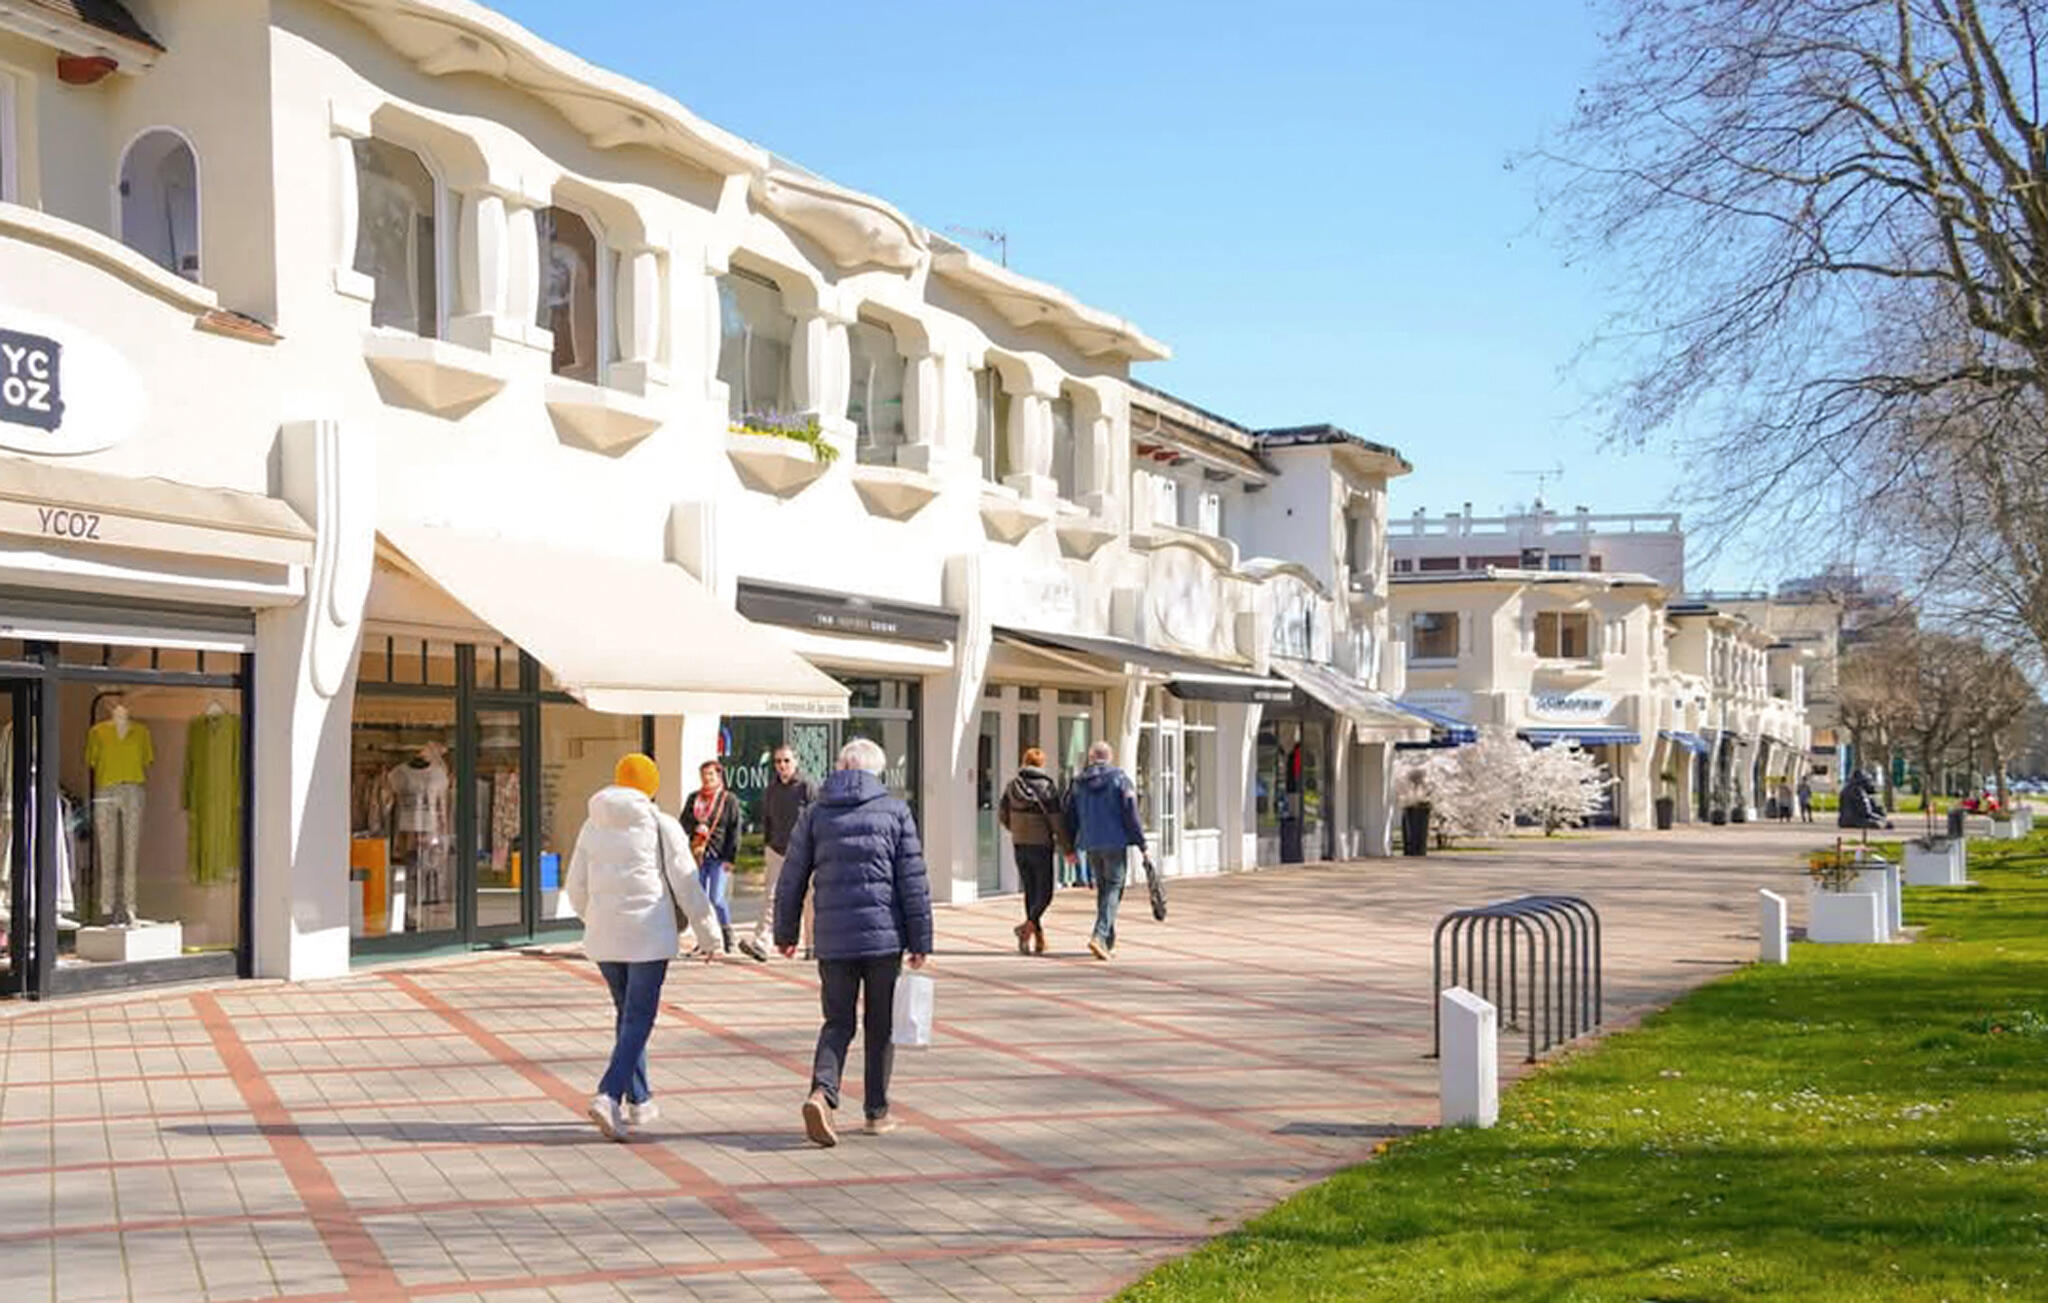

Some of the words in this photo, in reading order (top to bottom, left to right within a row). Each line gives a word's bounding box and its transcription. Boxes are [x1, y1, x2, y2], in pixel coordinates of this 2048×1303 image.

[2, 343, 50, 379] YC
[3, 377, 51, 411] OZ
[38, 507, 101, 540] YCOZ
